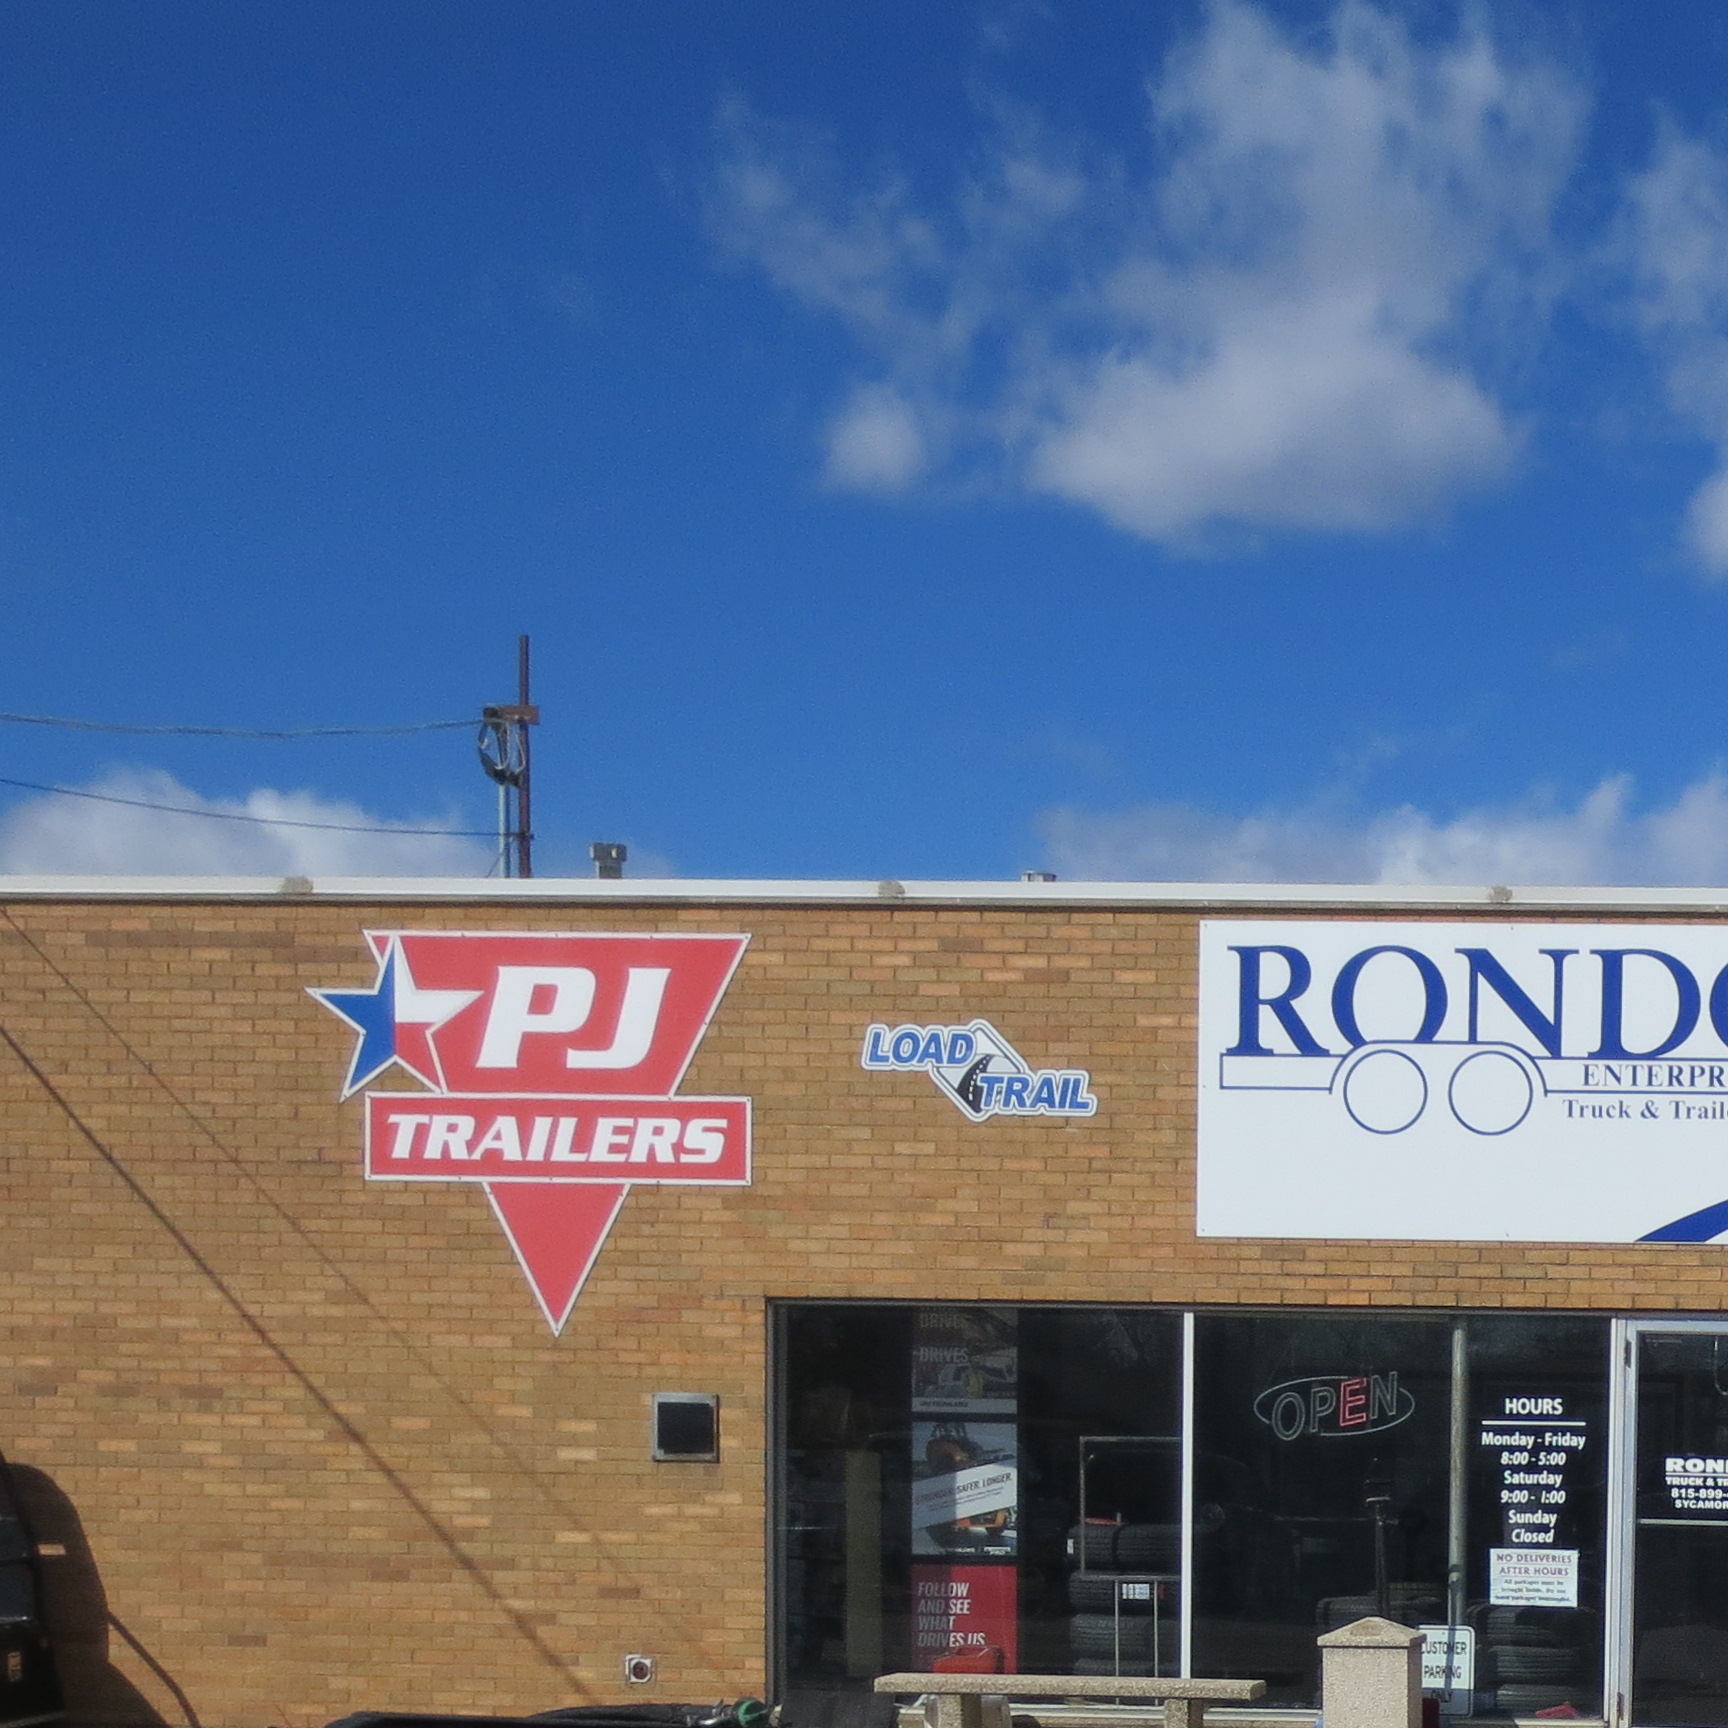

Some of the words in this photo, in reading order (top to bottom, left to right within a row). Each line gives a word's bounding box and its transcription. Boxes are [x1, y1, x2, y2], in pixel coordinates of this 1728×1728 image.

[475, 965, 672, 1070] PJ
[868, 1031, 975, 1065] LOAD
[977, 1075, 1091, 1110] TRAIL
[1562, 1098, 1632, 1120] Truck
[1639, 1099, 1661, 1120] &
[387, 1113, 729, 1165] TRAILERS
[919, 1346, 969, 1363] DRIVES
[1271, 1370, 1399, 1442] OPEN
[1504, 1397, 1564, 1415] HOURS
[1481, 1431, 1536, 1450] Monday
[1544, 1432, 1587, 1451] Friday
[1500, 1451, 1530, 1466] 8:00
[1537, 1451, 1567, 1466] 5:00
[1503, 1470, 1563, 1489] Saturday
[1665, 1476, 1705, 1486] TRUCK
[1705, 1477, 1715, 1487] &
[1500, 1489, 1530, 1504] 9:00
[1540, 1490, 1567, 1504] 1:00
[1508, 1509, 1558, 1528] Sunday
[1511, 1528, 1555, 1543] Closed
[1496, 1553, 1514, 1563] NO
[1516, 1553, 1572, 1564] DELIVERIES
[1499, 1566, 1531, 1576] AFTER
[1533, 1566, 1569, 1576] HOURS
[917, 1582, 970, 1598] FOLLOW
[917, 1599, 945, 1615] AND
[948, 1599, 972, 1615] SEE
[917, 1615, 957, 1631] WHAT
[916, 1632, 965, 1648] DRIVES
[967, 1632, 986, 1646] US
[1420, 1641, 1468, 1656] USTOMER
